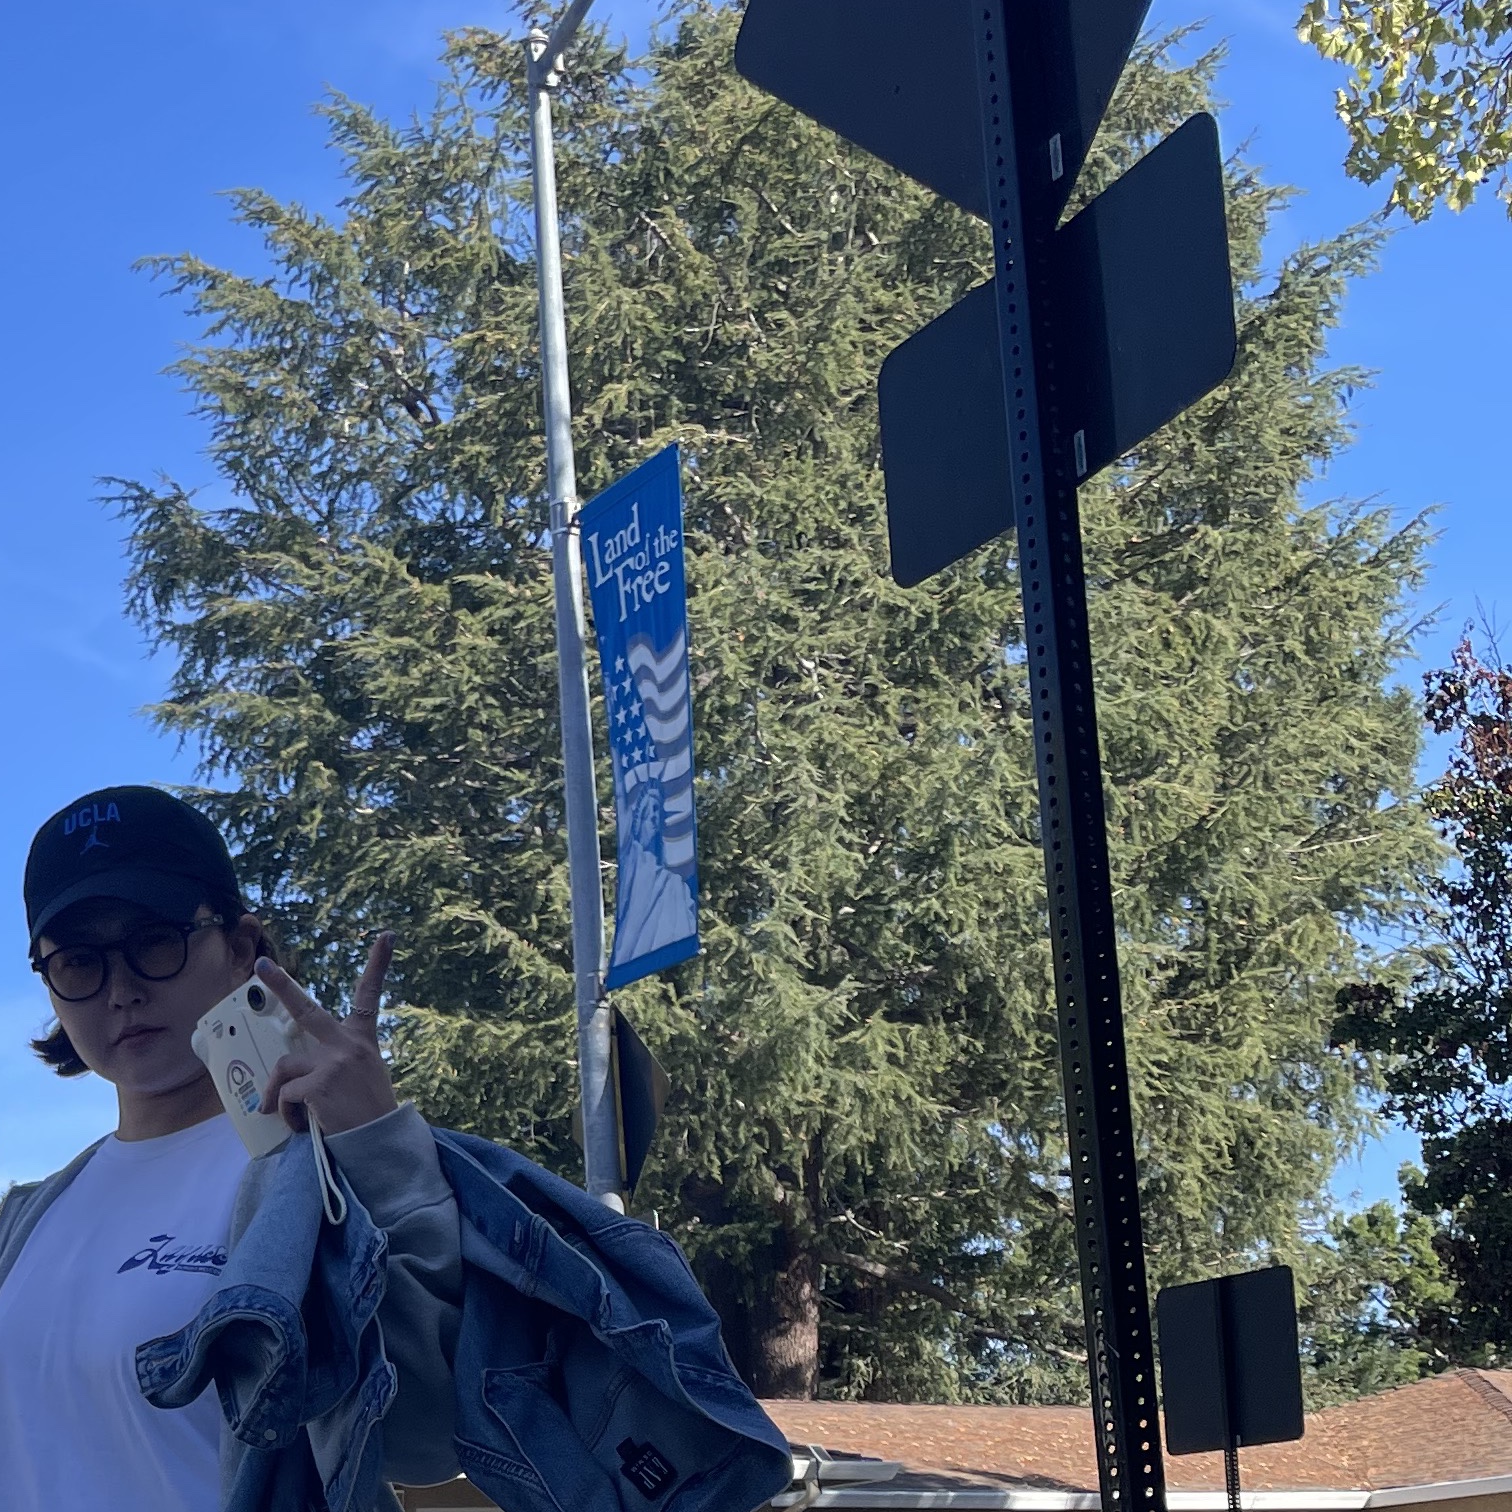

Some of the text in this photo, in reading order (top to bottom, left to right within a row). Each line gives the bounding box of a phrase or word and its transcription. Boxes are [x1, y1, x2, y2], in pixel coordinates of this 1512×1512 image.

[587, 501, 641, 589] Land
[634, 524, 678, 571] of the
[613, 556, 671, 623] Free
[64, 802, 121, 836] UCLA
[638, 1456, 668, 1490] GAP
